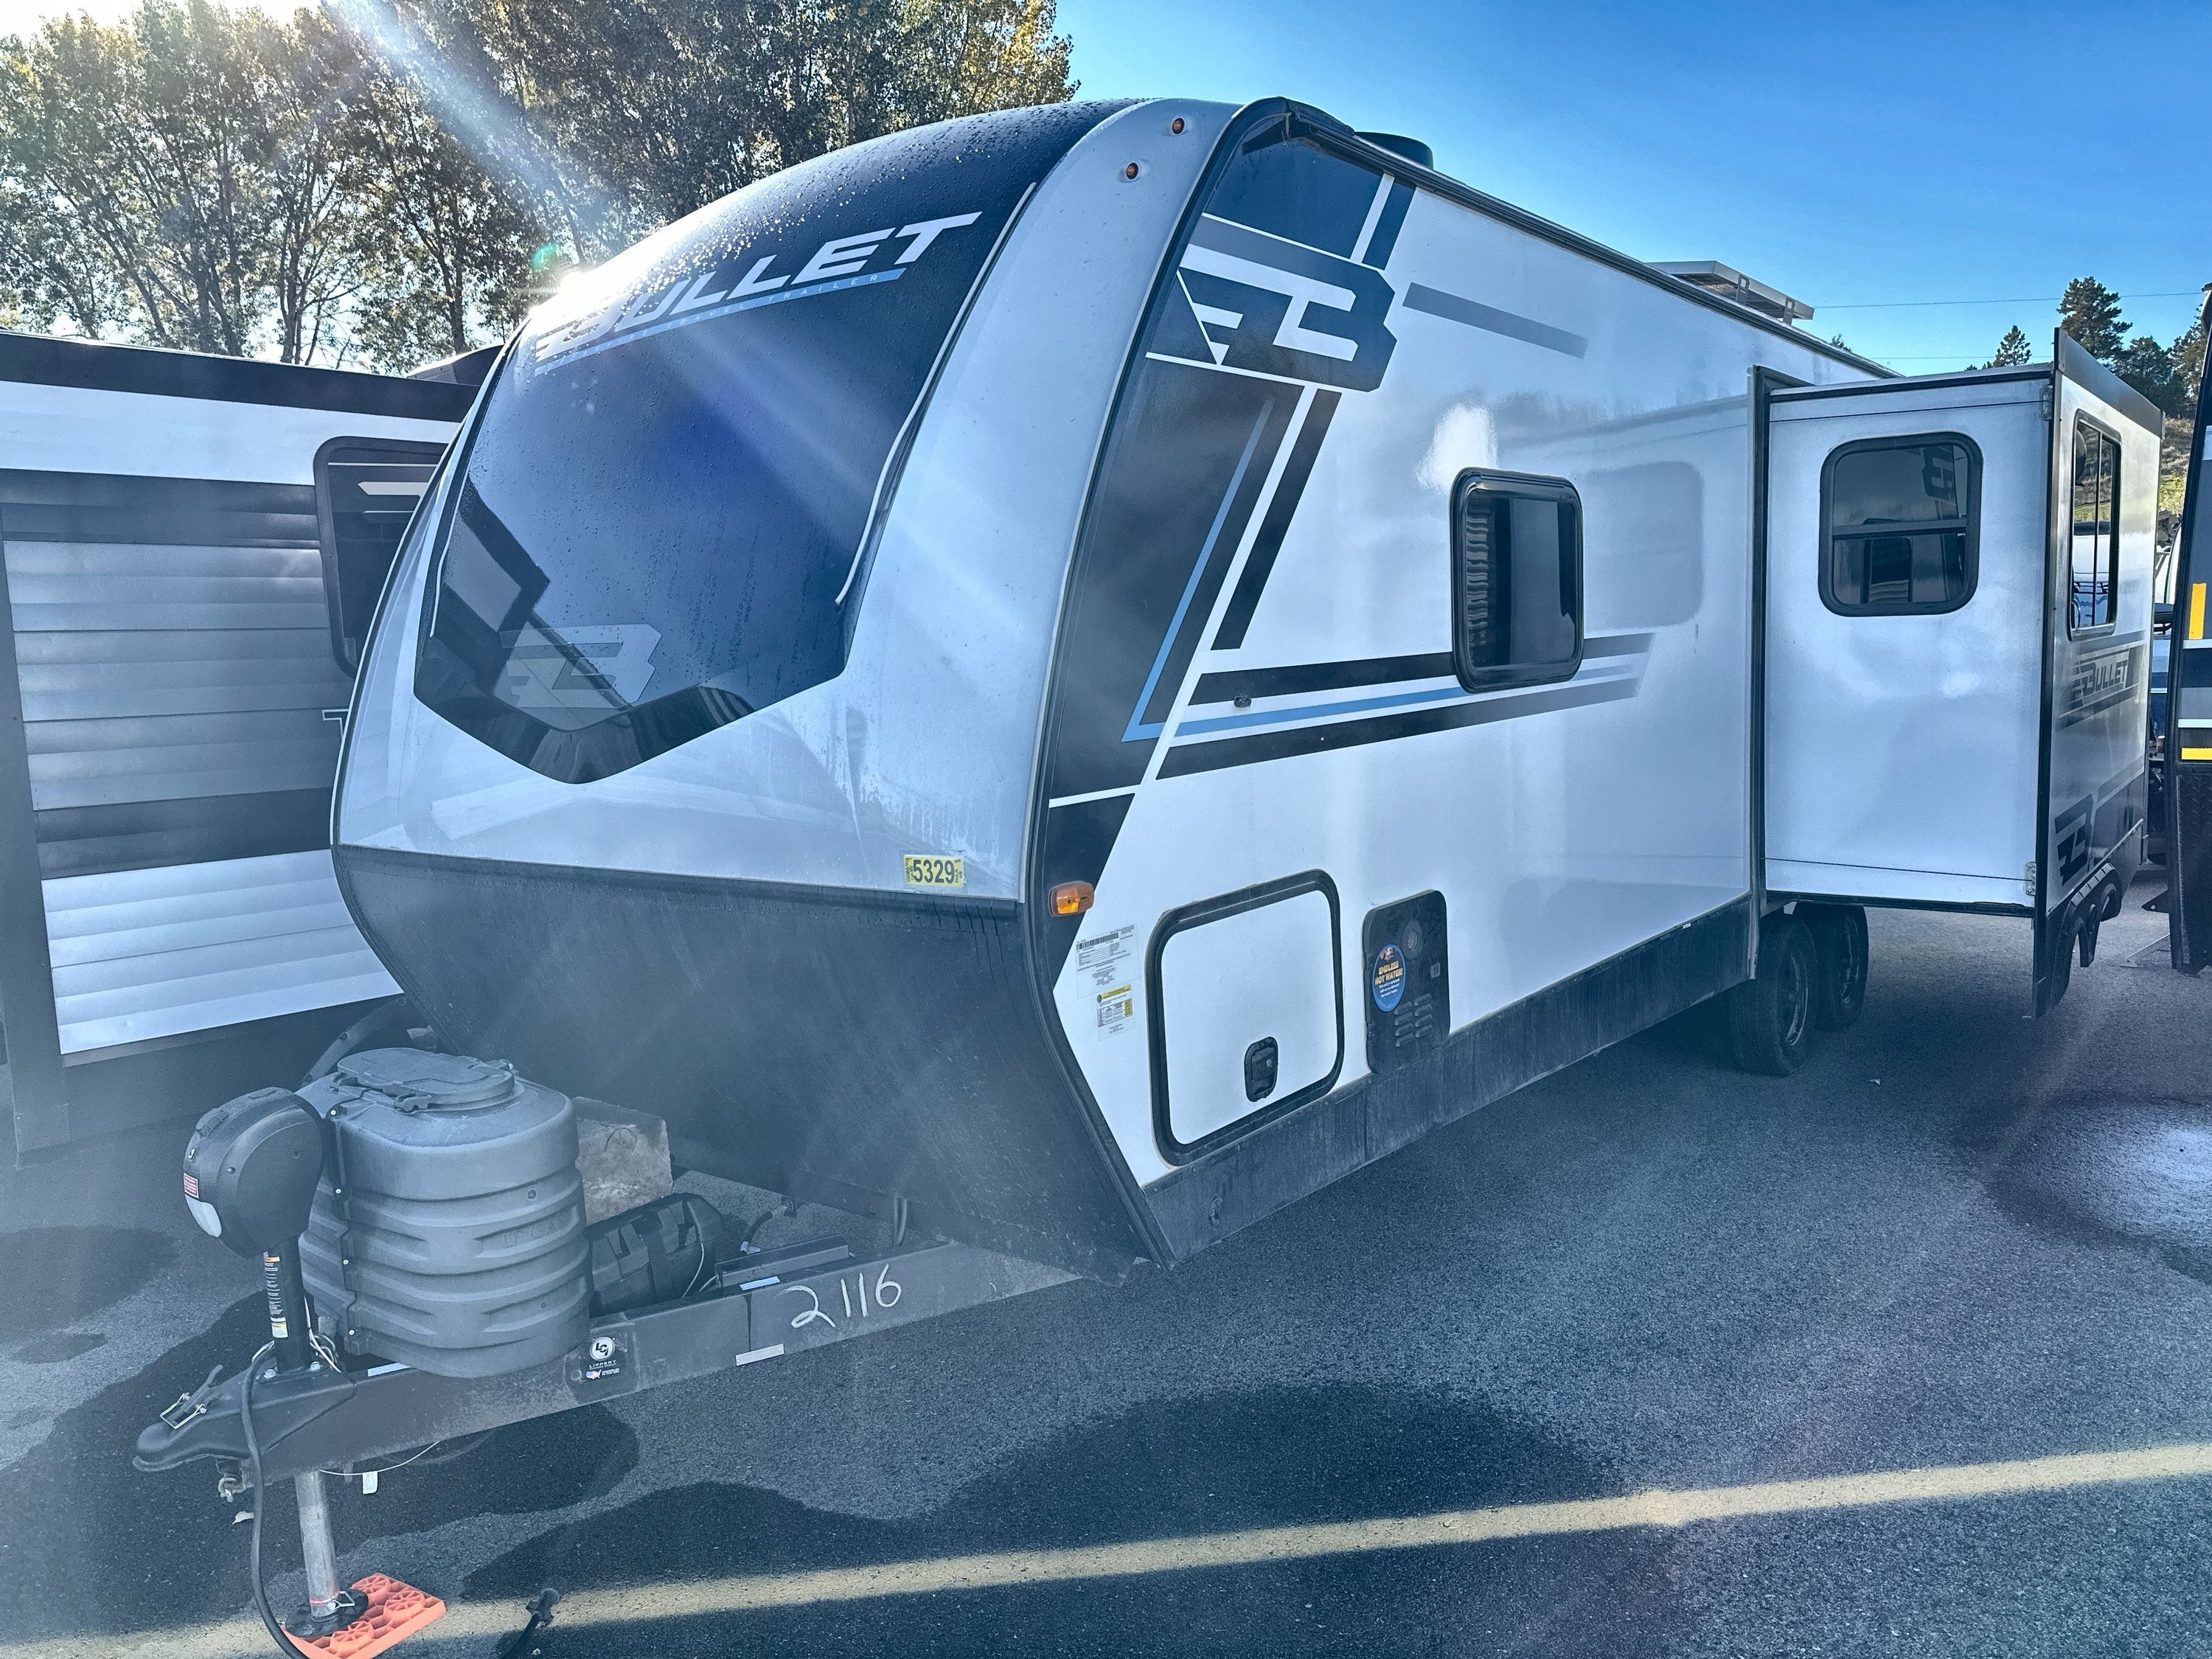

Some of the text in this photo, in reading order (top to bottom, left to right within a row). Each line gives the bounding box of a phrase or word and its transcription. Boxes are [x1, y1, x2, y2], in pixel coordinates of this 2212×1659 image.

[535, 211, 982, 362] BULLET
[666, 274, 879, 330] TRAVEL TRAILER
[2073, 660, 2128, 699] BULLET
[913, 859, 956, 884] 5329
[1374, 974, 1385, 986] HOT
[1378, 960, 1399, 975] ENDLESS
[530, 1214, 564, 1239] GAS
[774, 1264, 902, 1329] 2116
[588, 1360, 616, 1368] LIPPERT
